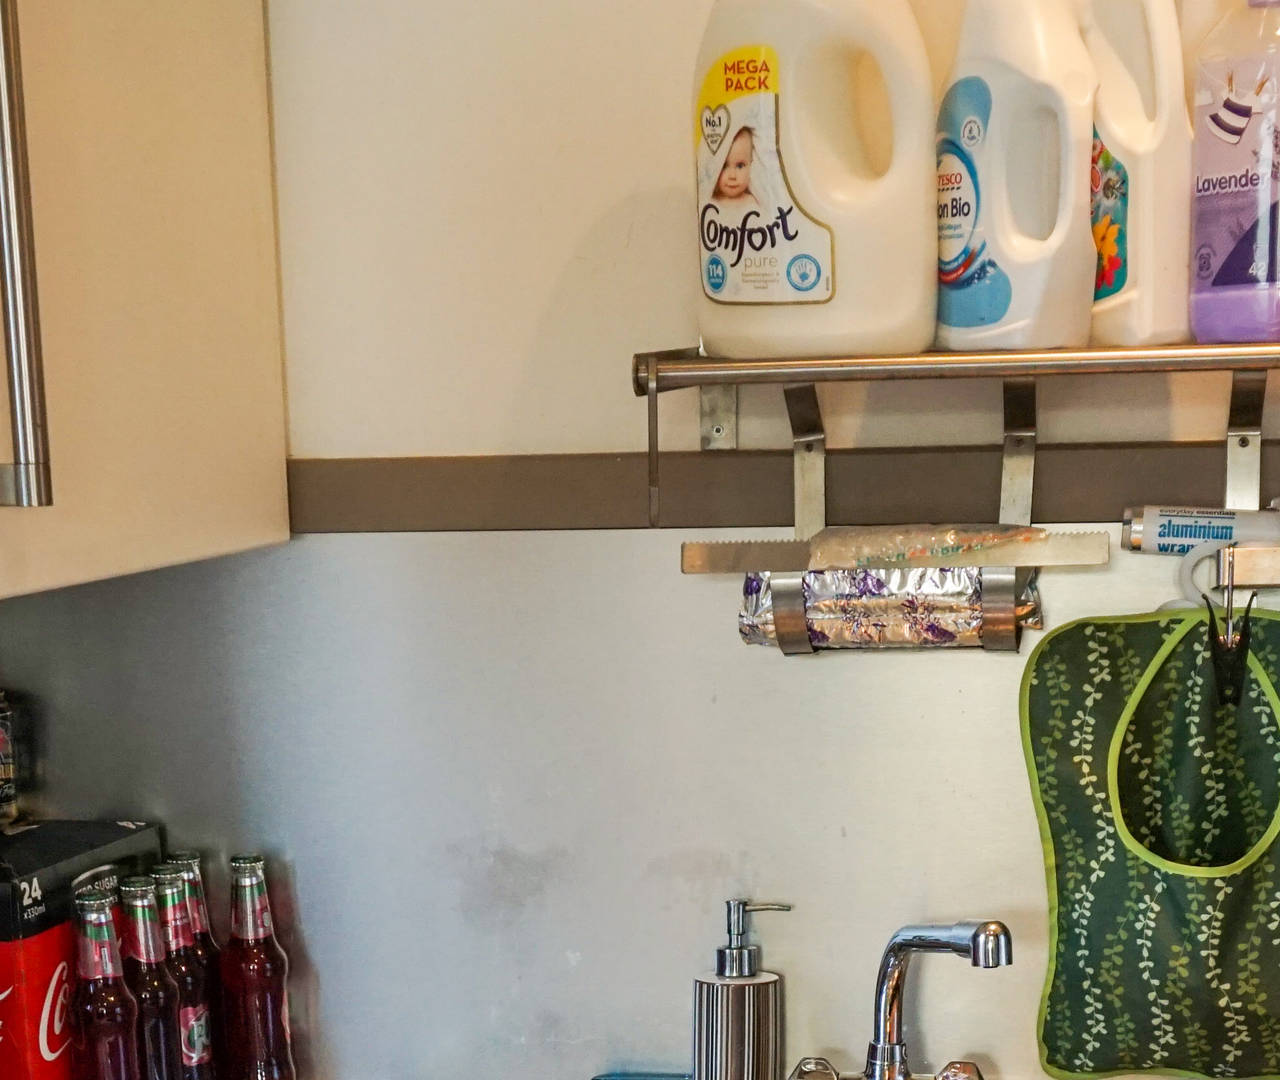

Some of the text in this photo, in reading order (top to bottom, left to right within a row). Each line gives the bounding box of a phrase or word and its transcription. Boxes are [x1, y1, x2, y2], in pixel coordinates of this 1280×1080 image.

[723, 59, 770, 75] MEGA
[725, 76, 769, 91] PACK
[705, 116, 721, 127] No.1
[937, 172, 963, 187] TESCO
[1195, 168, 1265, 193] Lavende
[937, 197, 971, 219] on Bio
[701, 203, 799, 268] Comfort
[707, 264, 723, 278] 114
[744, 256, 779, 272] pure
[1248, 262, 1267, 276] 42
[1158, 519, 1234, 541] aluminium
[20, 877, 42, 906] 24
